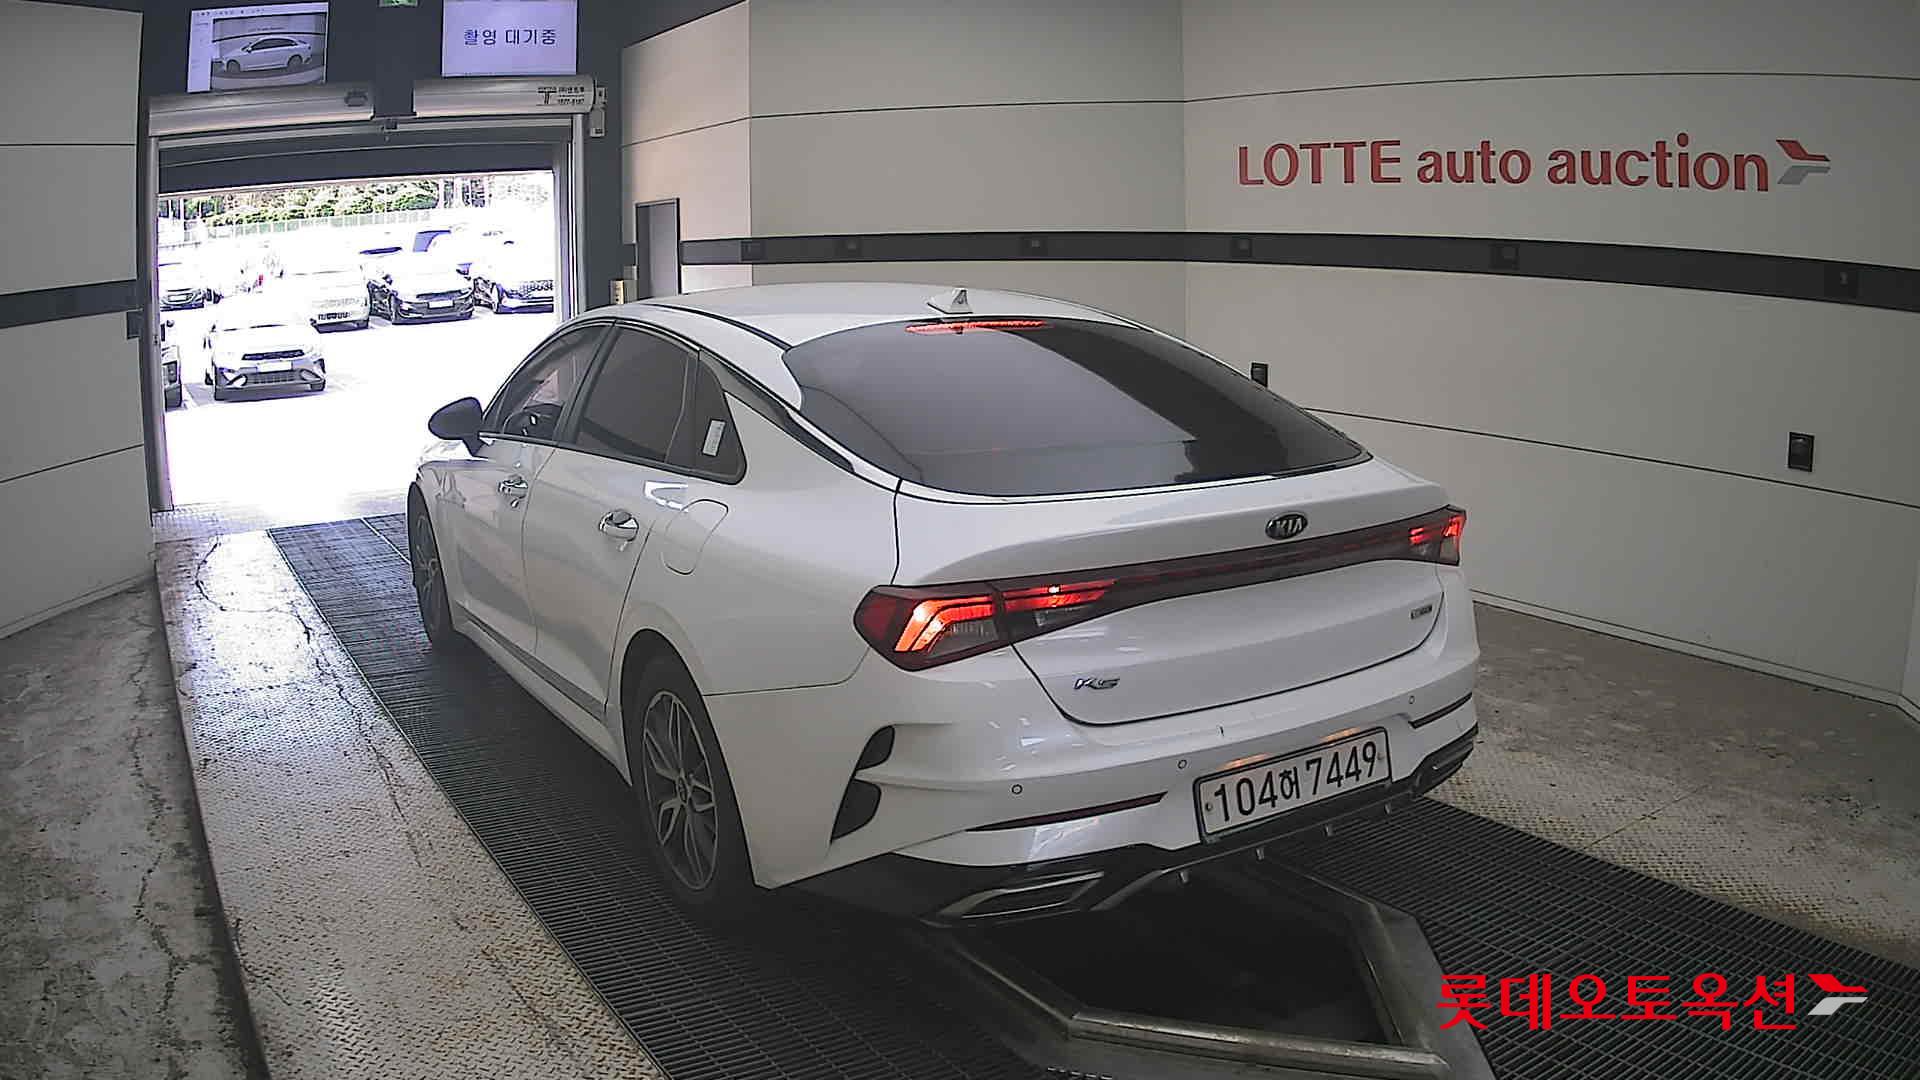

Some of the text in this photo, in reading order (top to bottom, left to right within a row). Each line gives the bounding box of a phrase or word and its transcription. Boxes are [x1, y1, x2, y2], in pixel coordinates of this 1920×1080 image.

[464, 29, 555, 45] 촬영 대기중
[1238, 132, 1769, 192] LOTTE auto auction
